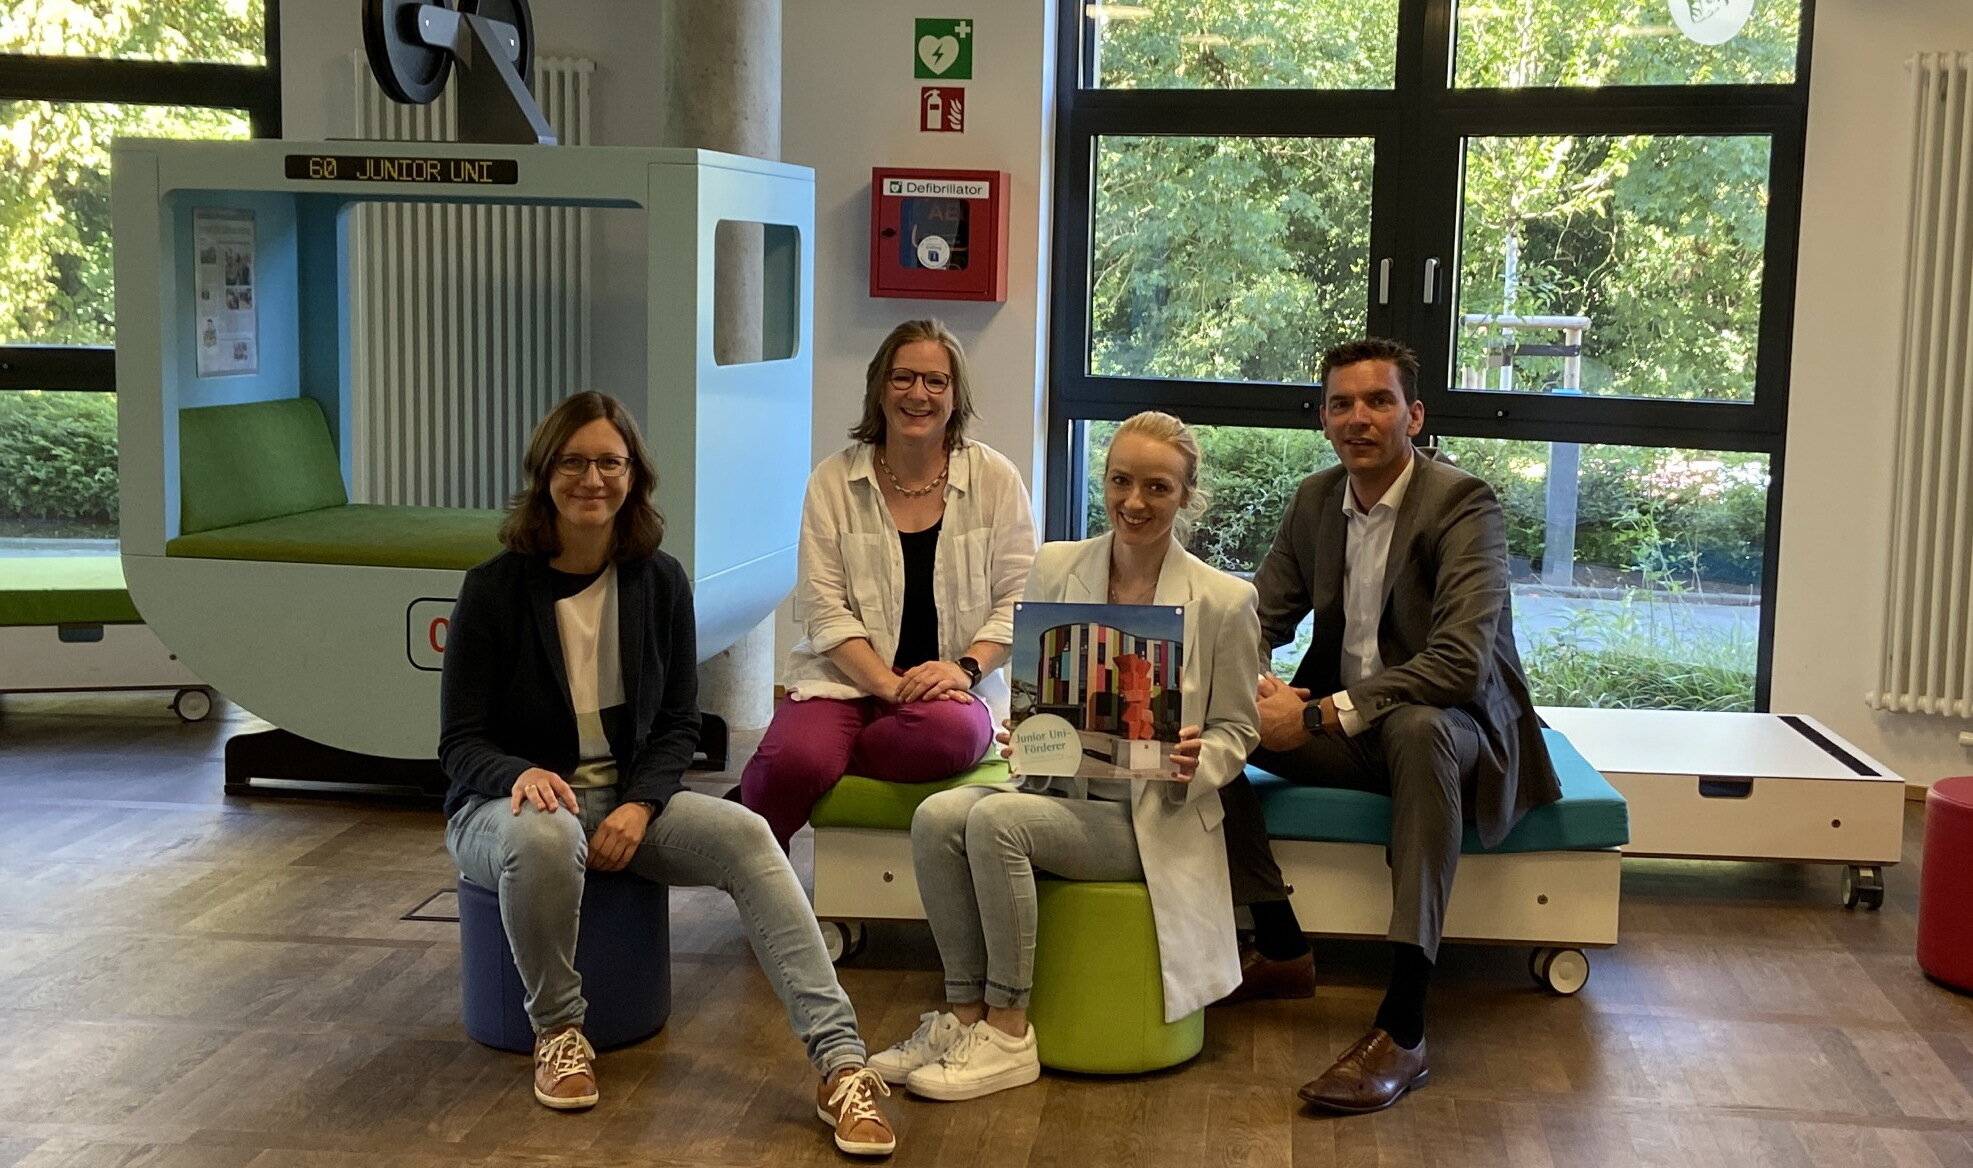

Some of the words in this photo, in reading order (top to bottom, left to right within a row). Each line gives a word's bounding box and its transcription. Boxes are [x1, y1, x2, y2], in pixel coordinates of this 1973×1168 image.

[309, 157, 337, 179] 60
[356, 158, 441, 182] JUNIOR
[450, 161, 493, 183] UNI
[906, 182, 983, 195] Defibrillator
[1015, 731, 1047, 744] Junior
[1024, 742, 1067, 754] Förderer
